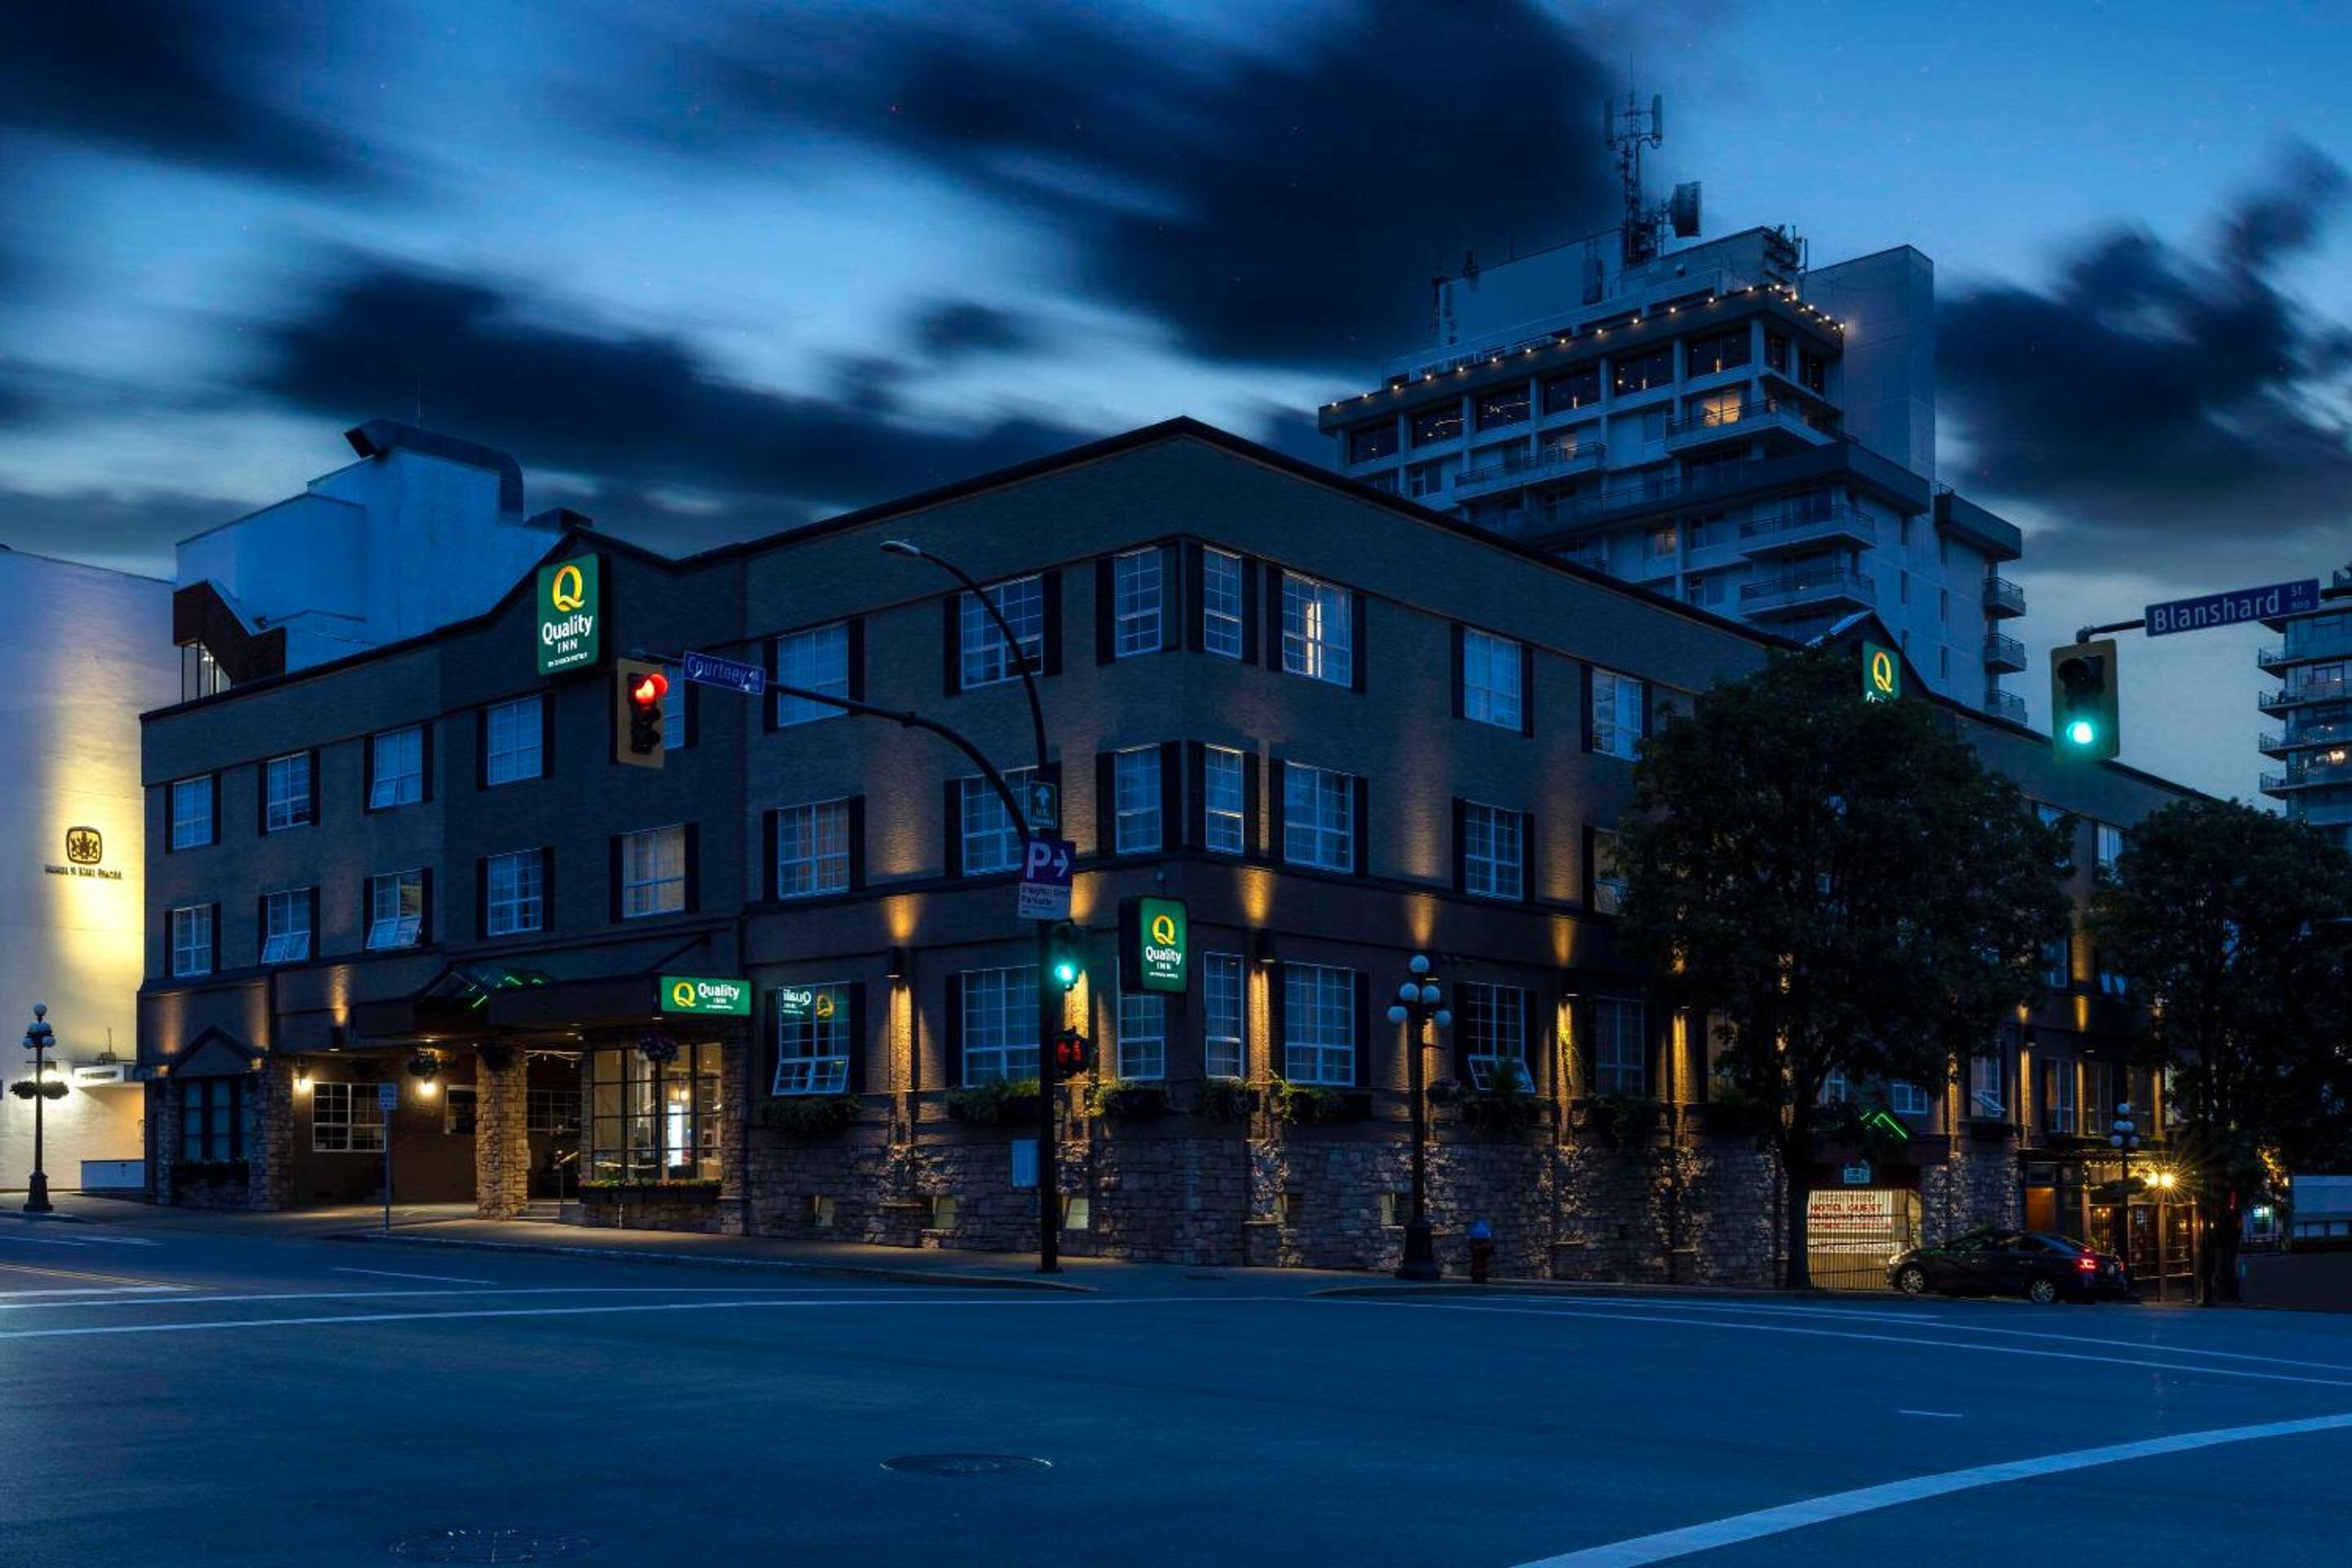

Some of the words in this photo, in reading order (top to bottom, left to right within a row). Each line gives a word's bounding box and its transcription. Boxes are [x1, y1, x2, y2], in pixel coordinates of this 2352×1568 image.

[553, 565, 585, 612] Q
[2154, 588, 2279, 632] Blanshard
[542, 614, 593, 645] Quality
[558, 638, 578, 653] INN
[688, 657, 747, 689] Courtney
[1873, 652, 1893, 693] Q
[1026, 841, 1052, 879] P
[1152, 915, 1176, 946] Q
[1145, 946, 1182, 965] Quality
[674, 982, 697, 1007] Q
[698, 982, 740, 1001] Quality
[1847, 1204, 1882, 1212] GUEST
